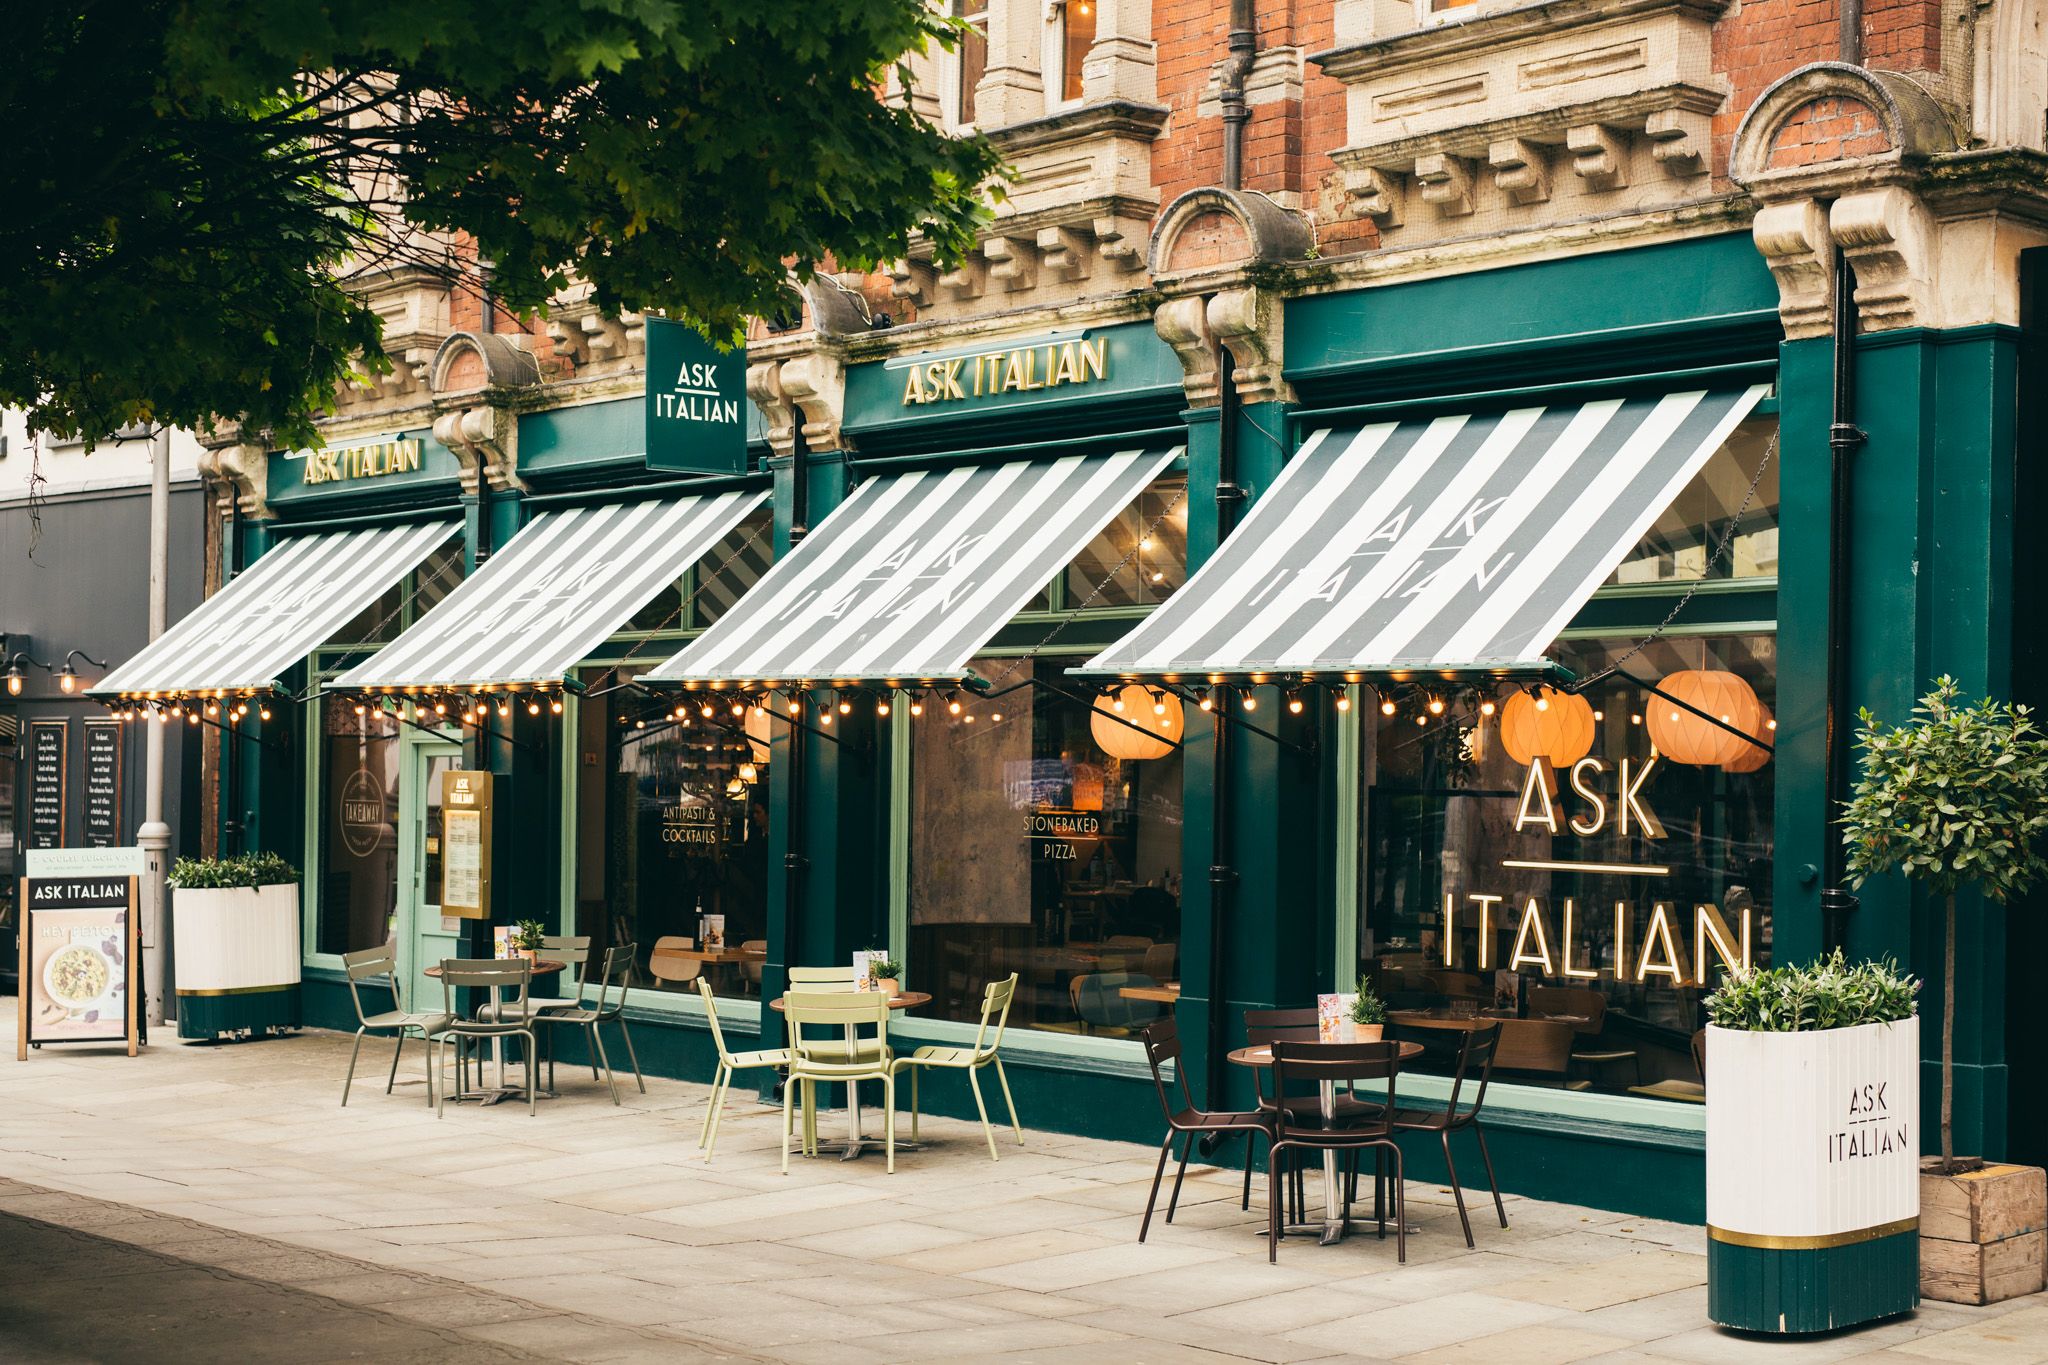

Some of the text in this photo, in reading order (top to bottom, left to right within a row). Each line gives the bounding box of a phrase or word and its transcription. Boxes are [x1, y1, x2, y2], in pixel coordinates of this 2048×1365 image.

[678, 362, 717, 388] ASK
[904, 337, 1109, 405] ASK ITALIAN
[657, 394, 737, 424] ITALIAN
[304, 436, 419, 484] ASK ITALIAN
[1361, 496, 1510, 543] AK
[874, 534, 988, 570] AK
[1248, 551, 1515, 606] IAIAN
[456, 778, 469, 789] ASK
[1513, 757, 1660, 838] ASK
[346, 803, 379, 822] TAKEAWAY
[663, 806, 715, 820] ANTIPASTI &
[1023, 816, 1098, 832] STONEBAKED
[662, 829, 716, 843] COCKTAILS
[1044, 844, 1077, 859] PIZZA
[35, 884, 124, 899] ASK ITALIAN
[1443, 893, 1750, 988] ITALIAN
[1850, 1081, 1887, 1115] ASK
[1829, 1123, 1906, 1163] ITALIAN
